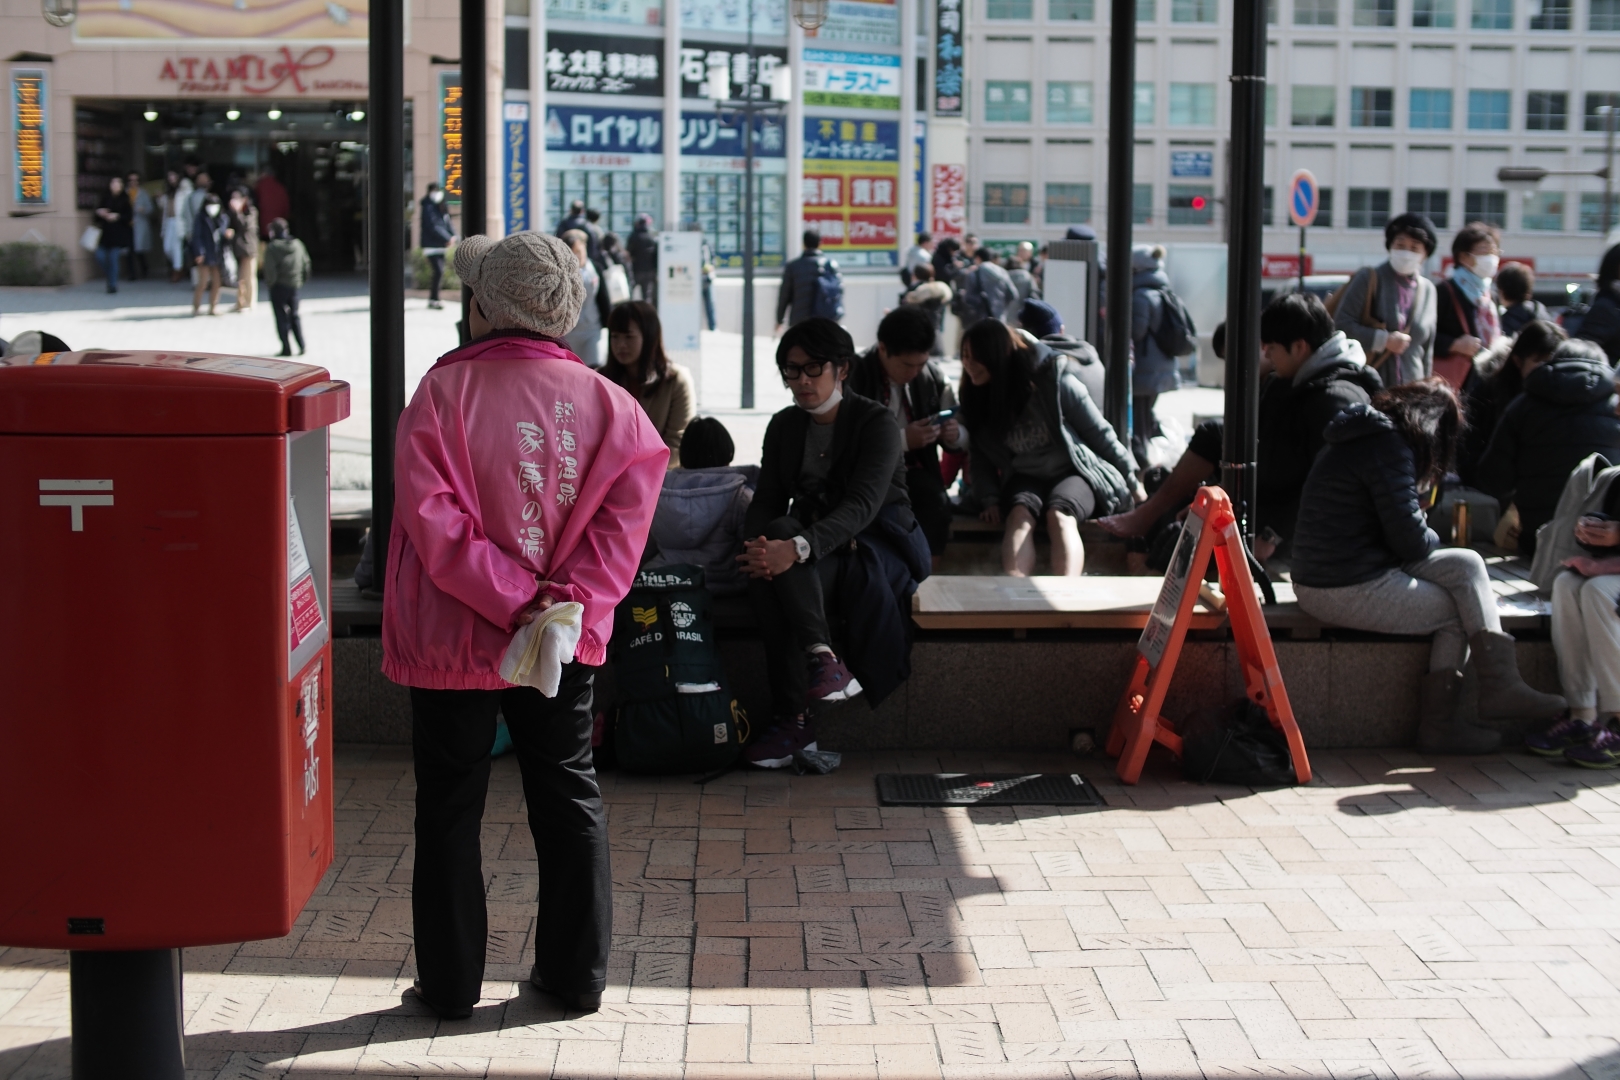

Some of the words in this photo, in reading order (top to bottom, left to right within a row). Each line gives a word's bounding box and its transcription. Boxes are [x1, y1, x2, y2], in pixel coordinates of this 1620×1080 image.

[825, 69, 891, 91] トラスト
[570, 114, 661, 147] ロイヤル
[817, 119, 878, 141] 不動産
[802, 139, 897, 160] ゾートギャラリー
[554, 400, 579, 507] 熱海温泉
[516, 421, 547, 559] 家康の湯
[675, 631, 704, 642] RASIL
